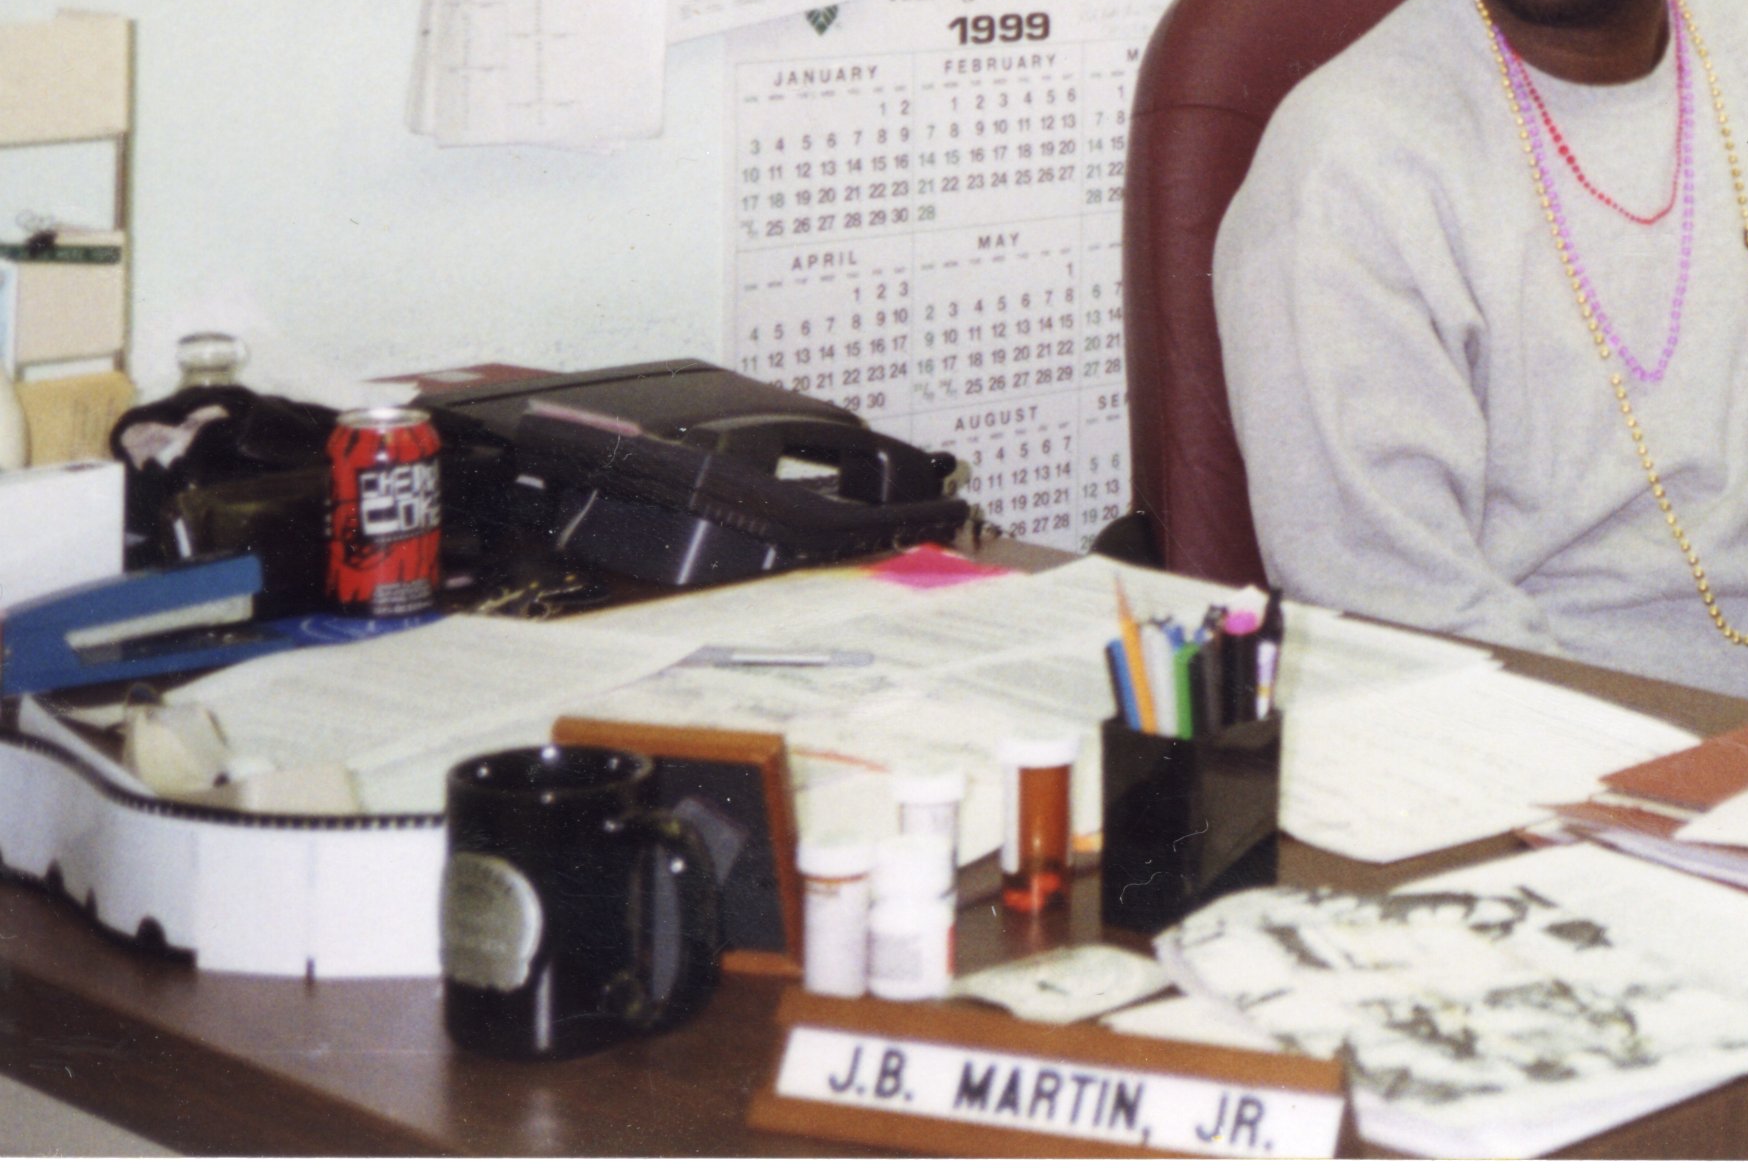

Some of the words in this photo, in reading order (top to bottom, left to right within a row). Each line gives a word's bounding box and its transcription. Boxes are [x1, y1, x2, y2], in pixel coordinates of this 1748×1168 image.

[948, 12, 1051, 46] 1999
[774, 65, 878, 87] JANUARY
[944, 54, 1057, 75] FEBRUARY
[900, 99, 910, 116] 2
[950, 96, 958, 111] 1
[975, 94, 985, 110] 2
[999, 92, 1008, 108] 3
[1024, 91, 1032, 104] 4
[1046, 89, 1056, 104] 5
[1067, 88, 1076, 102] 6
[949, 122, 960, 138] 8
[975, 120, 985, 136] 9
[992, 119, 1009, 134] 10
[1017, 117, 1031, 132] 11
[1040, 114, 1055, 130] 12
[1061, 113, 1076, 129] 13
[750, 139, 761, 155] 3
[775, 137, 784, 152] 4
[801, 134, 812, 151] 5
[826, 132, 837, 148] 6
[853, 129, 863, 146] 7
[877, 128, 887, 144] 8
[900, 126, 910, 142] 9
[944, 149, 960, 165] 15
[969, 147, 985, 162] 16
[992, 144, 1008, 160] 17
[1017, 143, 1032, 159] 18
[1040, 141, 1055, 156] 19
[1059, 138, 1076, 155] 20
[1111, 136, 1126, 151] 15
[741, 166, 761, 184] 10
[768, 164, 783, 180] 11
[795, 161, 812, 178] 12
[820, 160, 837, 176] 13
[846, 158, 862, 173] 14
[871, 155, 887, 172] 15
[894, 154, 909, 169] 16
[941, 176, 960, 192] 22
[966, 173, 985, 190] 23
[990, 172, 1008, 187] 24
[1015, 169, 1033, 186] 25
[1037, 167, 1055, 183] 26
[1057, 164, 1075, 181] 27
[1108, 161, 1124, 177] 22
[767, 192, 786, 208] 18
[795, 189, 812, 206] 19
[818, 187, 836, 204] 20
[844, 185, 861, 202] 21
[868, 182, 886, 199] 22
[891, 180, 910, 197] 23
[765, 219, 785, 237] 25
[793, 217, 811, 234] 26
[817, 214, 836, 232] 27
[844, 212, 862, 229] 28
[869, 210, 887, 226] 29
[891, 207, 909, 223] 30
[977, 232, 1020, 250] MAY
[792, 251, 857, 271] APRIL
[853, 287, 861, 302] 1
[876, 283, 887, 300] 2
[899, 281, 909, 297] 3
[925, 304, 935, 322] 2
[949, 302, 959, 318] 3
[974, 299, 984, 313] 4
[997, 295, 1007, 312] 5
[1021, 293, 1031, 308] 6
[1044, 289, 1054, 305] 7
[1065, 287, 1074, 304] 8
[774, 323, 784, 340] 5
[800, 320, 811, 336] 6
[825, 315, 836, 332] 7
[851, 313, 862, 330] 8
[876, 311, 886, 327] 9
[892, 307, 909, 324] 10
[924, 331, 935, 347] 9
[941, 328, 959, 344] 10
[968, 325, 982, 341] 11
[991, 321, 1007, 338] 12
[1015, 318, 1031, 336] 13
[1038, 316, 1053, 331] 14
[1059, 313, 1074, 329] 15
[768, 351, 784, 368] 12
[794, 347, 811, 364] 13
[819, 345, 835, 360] 14
[844, 340, 861, 357] 15
[870, 338, 886, 354] 16
[892, 334, 908, 351] 17
[1106, 333, 1121, 349] 21
[941, 354, 958, 370] 17
[968, 351, 983, 368] 18
[991, 348, 1006, 365] 19
[1013, 345, 1031, 362] 20
[1036, 342, 1052, 359] 21
[1057, 339, 1074, 356] 22
[1105, 358, 1120, 374] 28
[817, 372, 833, 389] 21
[843, 368, 861, 386] 22
[867, 364, 886, 382] 23
[890, 362, 908, 379] 24
[965, 378, 983, 395] 25
[988, 375, 1006, 391] 26
[1012, 371, 1030, 388] 27
[1035, 368, 1053, 385] 28
[1056, 365, 1073, 382] 29
[868, 391, 886, 408] 30
[955, 406, 1038, 432] AUGUST
[973, 450, 982, 466] 3
[996, 447, 1005, 461] 4
[1020, 442, 1029, 459] 5
[1042, 439, 1051, 454] 6
[1063, 435, 1072, 451] 7
[967, 477, 982, 492] 10
[988, 472, 1003, 488] 11
[1012, 468, 1028, 485] 12
[1034, 464, 1051, 481] 13
[1056, 461, 1071, 477] 14
[1105, 478, 1120, 494] 13
[988, 498, 1004, 514] 18
[1011, 494, 1028, 510] 19
[1033, 491, 1051, 508] 20
[1054, 488, 1069, 504] 21
[1032, 516, 1050, 533] 27
[1053, 512, 1070, 530] 28
[828, 1045, 914, 1102] J.B.
[952, 1061, 1153, 1148] MARTIN,
[1195, 1091, 1274, 1152] JR.
